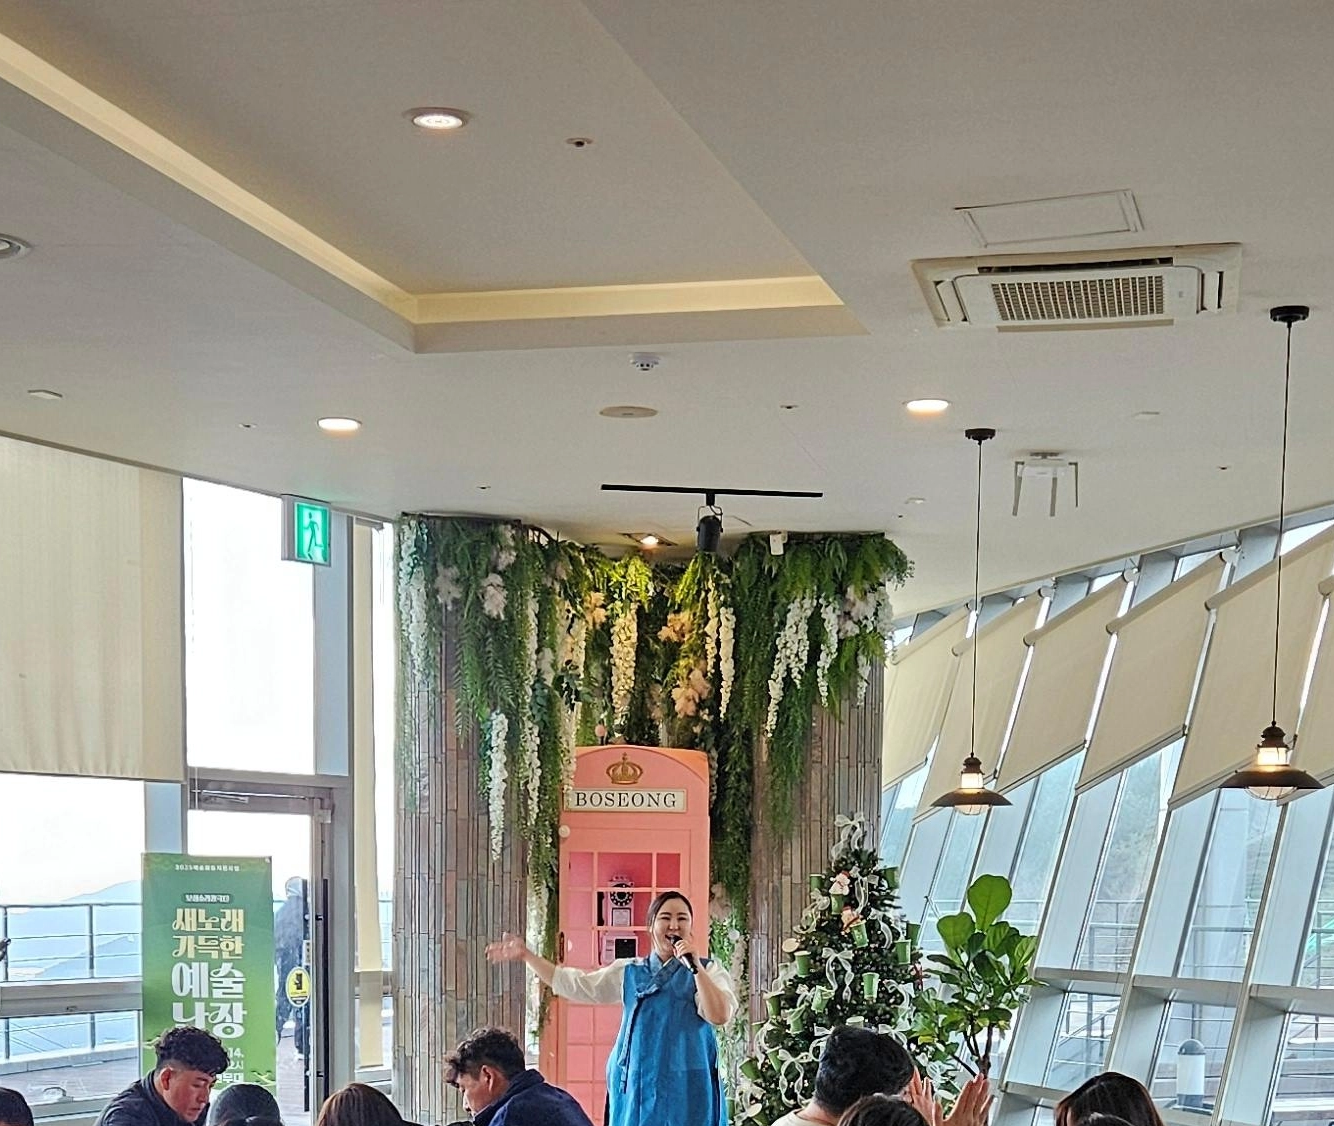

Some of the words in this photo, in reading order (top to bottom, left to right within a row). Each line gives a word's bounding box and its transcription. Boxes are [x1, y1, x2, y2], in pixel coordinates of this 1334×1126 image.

[575, 792, 676, 808] BOSEONG
[172, 908, 244, 932] 새노래
[172, 935, 245, 959] 가득한
[172, 962, 246, 998] 예술
